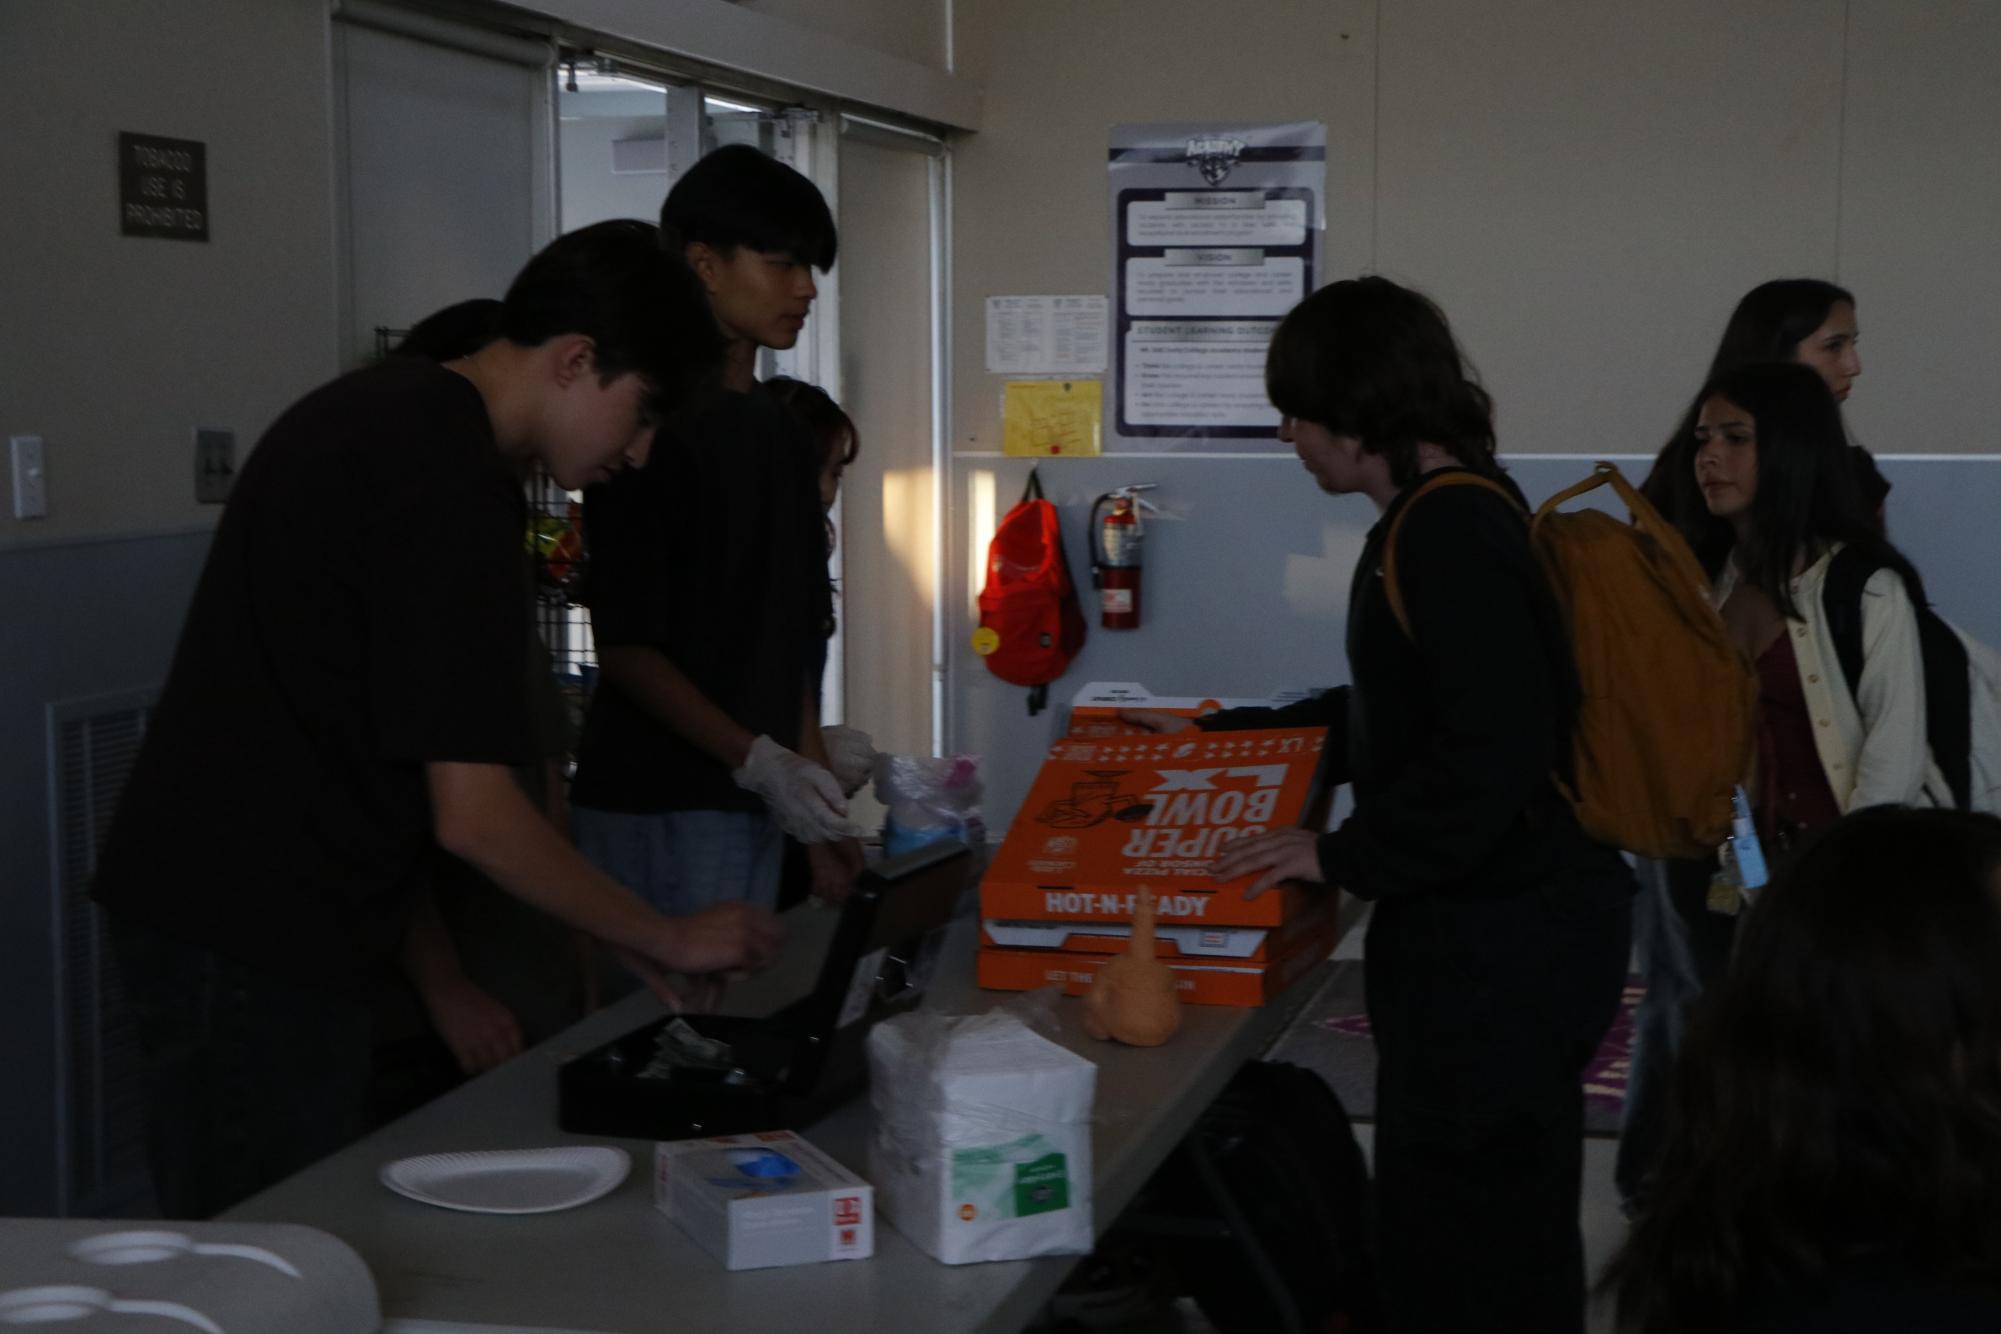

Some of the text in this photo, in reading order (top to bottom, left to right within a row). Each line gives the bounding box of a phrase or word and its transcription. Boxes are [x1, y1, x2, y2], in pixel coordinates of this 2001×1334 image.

[133, 145, 192, 174] TOBACCO
[142, 176, 185, 200] USE IS
[126, 202, 202, 230] PROHIBITED
[1149, 763, 1290, 793] LX
[1142, 789, 1280, 827] BOWL
